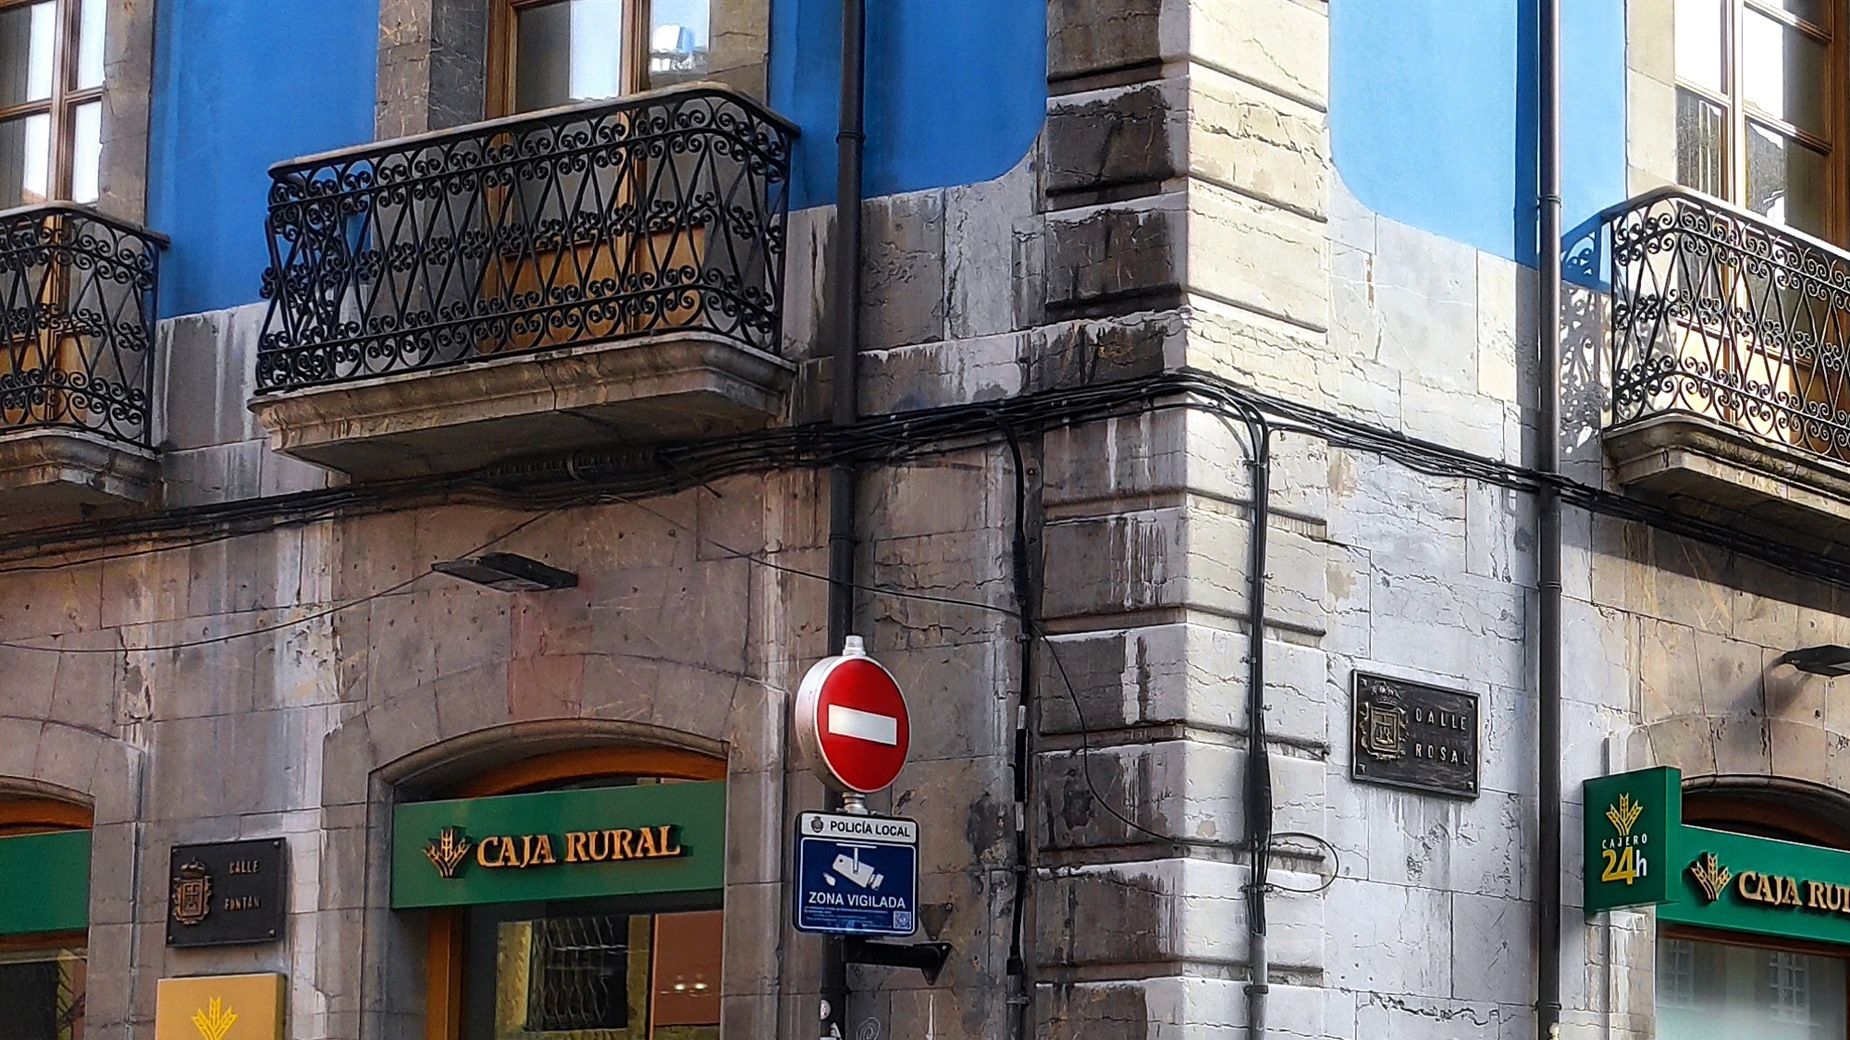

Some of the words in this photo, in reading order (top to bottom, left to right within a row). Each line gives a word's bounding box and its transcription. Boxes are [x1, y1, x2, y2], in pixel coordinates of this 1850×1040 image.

[1415, 743, 1469, 765] ROSAL
[830, 820, 873, 834] POLICÍA
[875, 825, 911, 838] LOCAL
[477, 834, 557, 869] CAJA
[565, 825, 681, 863] RURAL
[1601, 833, 1648, 850] CAJERO
[229, 860, 259, 874] CALLE
[1601, 846, 1648, 885] 24h
[1738, 871, 1802, 906] CAJA
[808, 891, 845, 906] ZONA
[847, 894, 907, 909] VIGILADA
